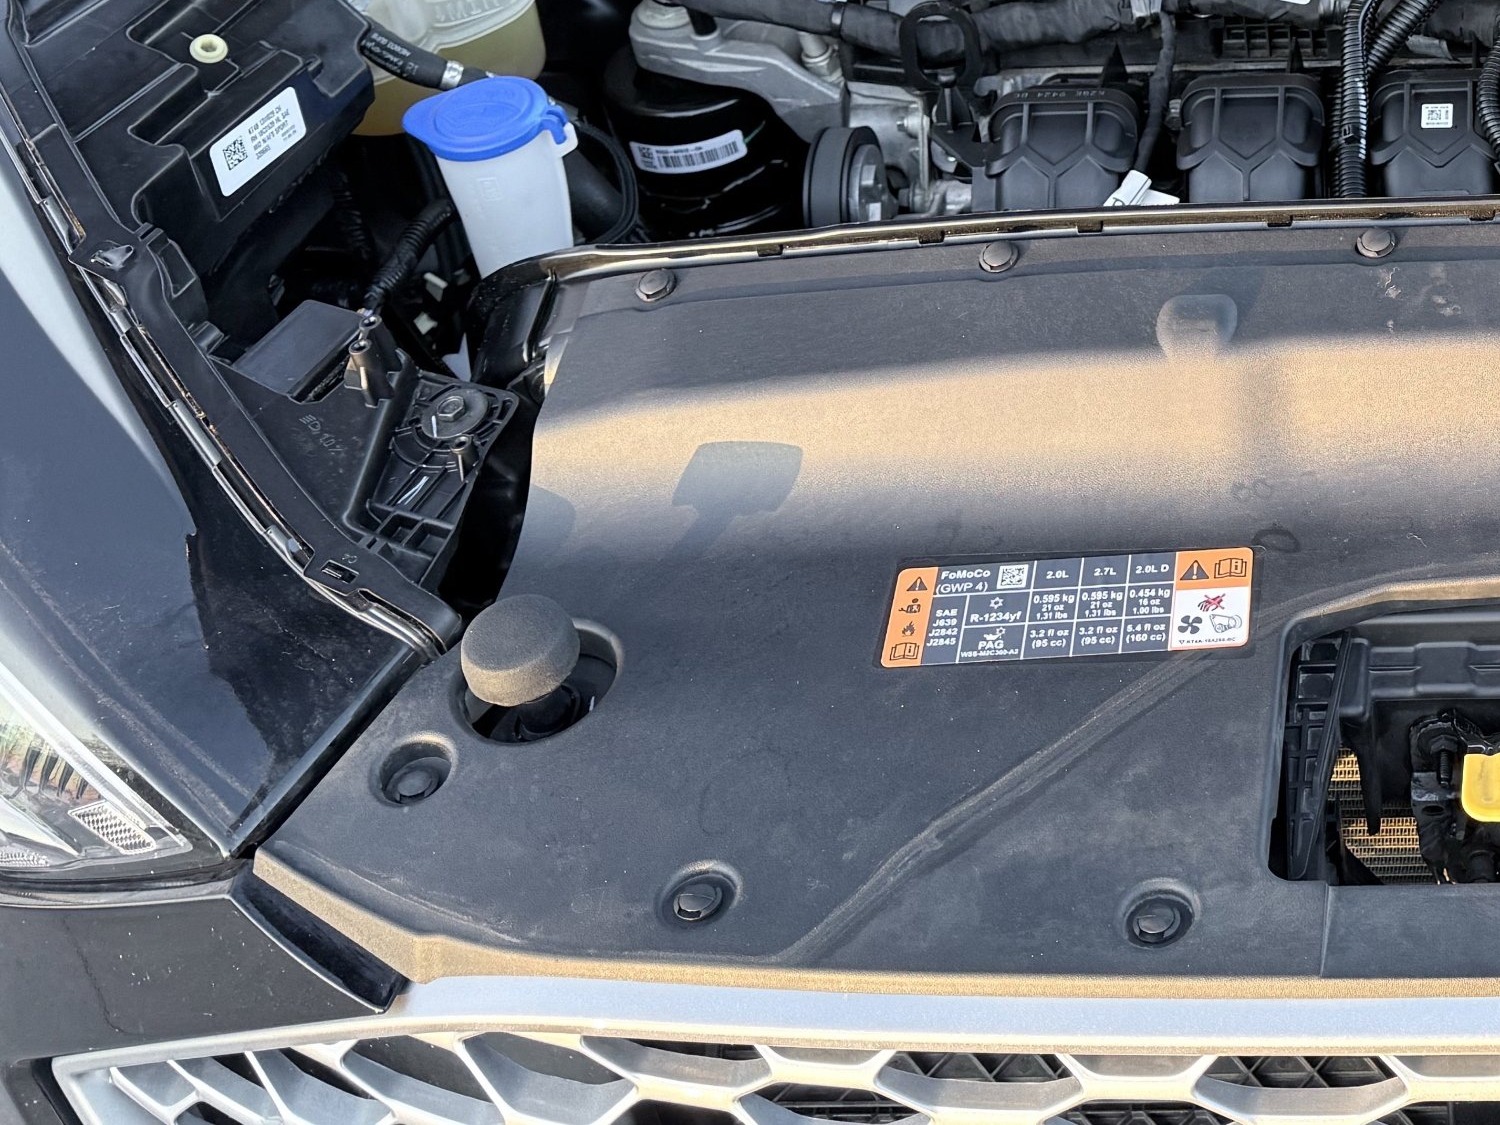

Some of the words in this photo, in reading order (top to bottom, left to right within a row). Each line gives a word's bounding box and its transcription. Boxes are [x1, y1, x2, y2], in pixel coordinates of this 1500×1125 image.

[1094, 567, 1117, 576] 2.7L
[1135, 565, 1158, 574] 2.0L
[1160, 563, 1170, 573] D
[941, 569, 991, 580] FoMoCo
[1046, 570, 1069, 579] 2.0L
[935, 582, 973, 595] (GWP
[975, 581, 989, 592] 4)
[1129, 589, 1156, 598] 0.454
[1157, 588, 1171, 598] kg
[1033, 593, 1061, 604] 0.595
[1062, 592, 1075, 603] kg
[1081, 591, 1109, 601] 0.595
[1110, 590, 1123, 601] kg
[935, 608, 959, 617] SAE
[1084, 610, 1102, 618] 1.31
[1103, 608, 1117, 617] lbs
[1132, 607, 1150, 615] 1.00
[1151, 606, 1165, 614] lbs
[970, 611, 1022, 623] R-1234yf
[1036, 612, 1053, 620] 1.31
[932, 618, 958, 627] J639
[928, 628, 958, 637] J2842
[1029, 629, 1046, 638] 3.2
[1078, 627, 1095, 636] 3.2
[1105, 626, 1118, 634] oz
[1126, 624, 1143, 633] 5.4
[1144, 624, 1152, 632] fl
[926, 637, 957, 647] J2845
[1081, 636, 1097, 647] (95
[1099, 635, 1115, 645] cc)
[1125, 633, 1149, 643] (160
[1150, 632, 1166, 641] cc)
[977, 639, 1004, 650] PAG
[1031, 638, 1048, 649] (95
[1050, 638, 1066, 648] cc)
